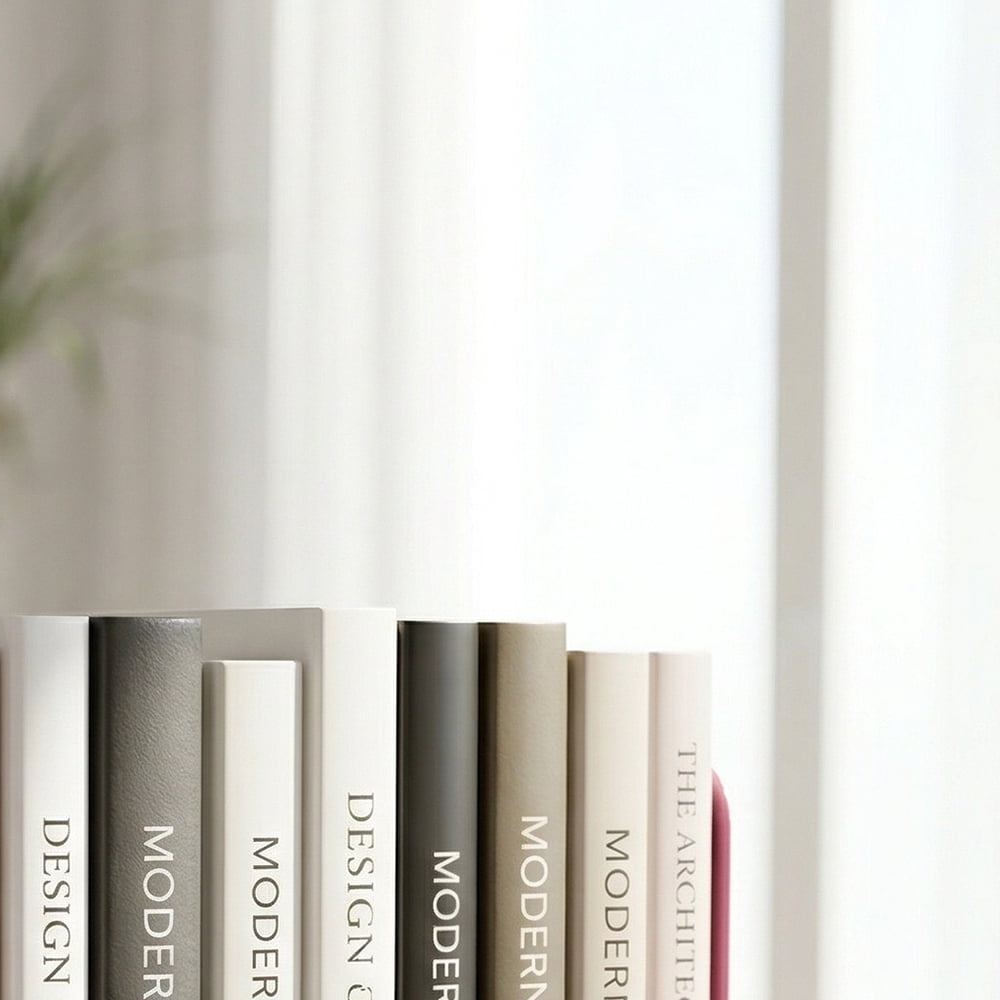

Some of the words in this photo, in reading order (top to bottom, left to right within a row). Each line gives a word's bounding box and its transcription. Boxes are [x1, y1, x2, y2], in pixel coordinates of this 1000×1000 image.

[677, 743, 698, 819] THE
[43, 818, 73, 985] DESIGN
[347, 793, 376, 965] DESIGN
